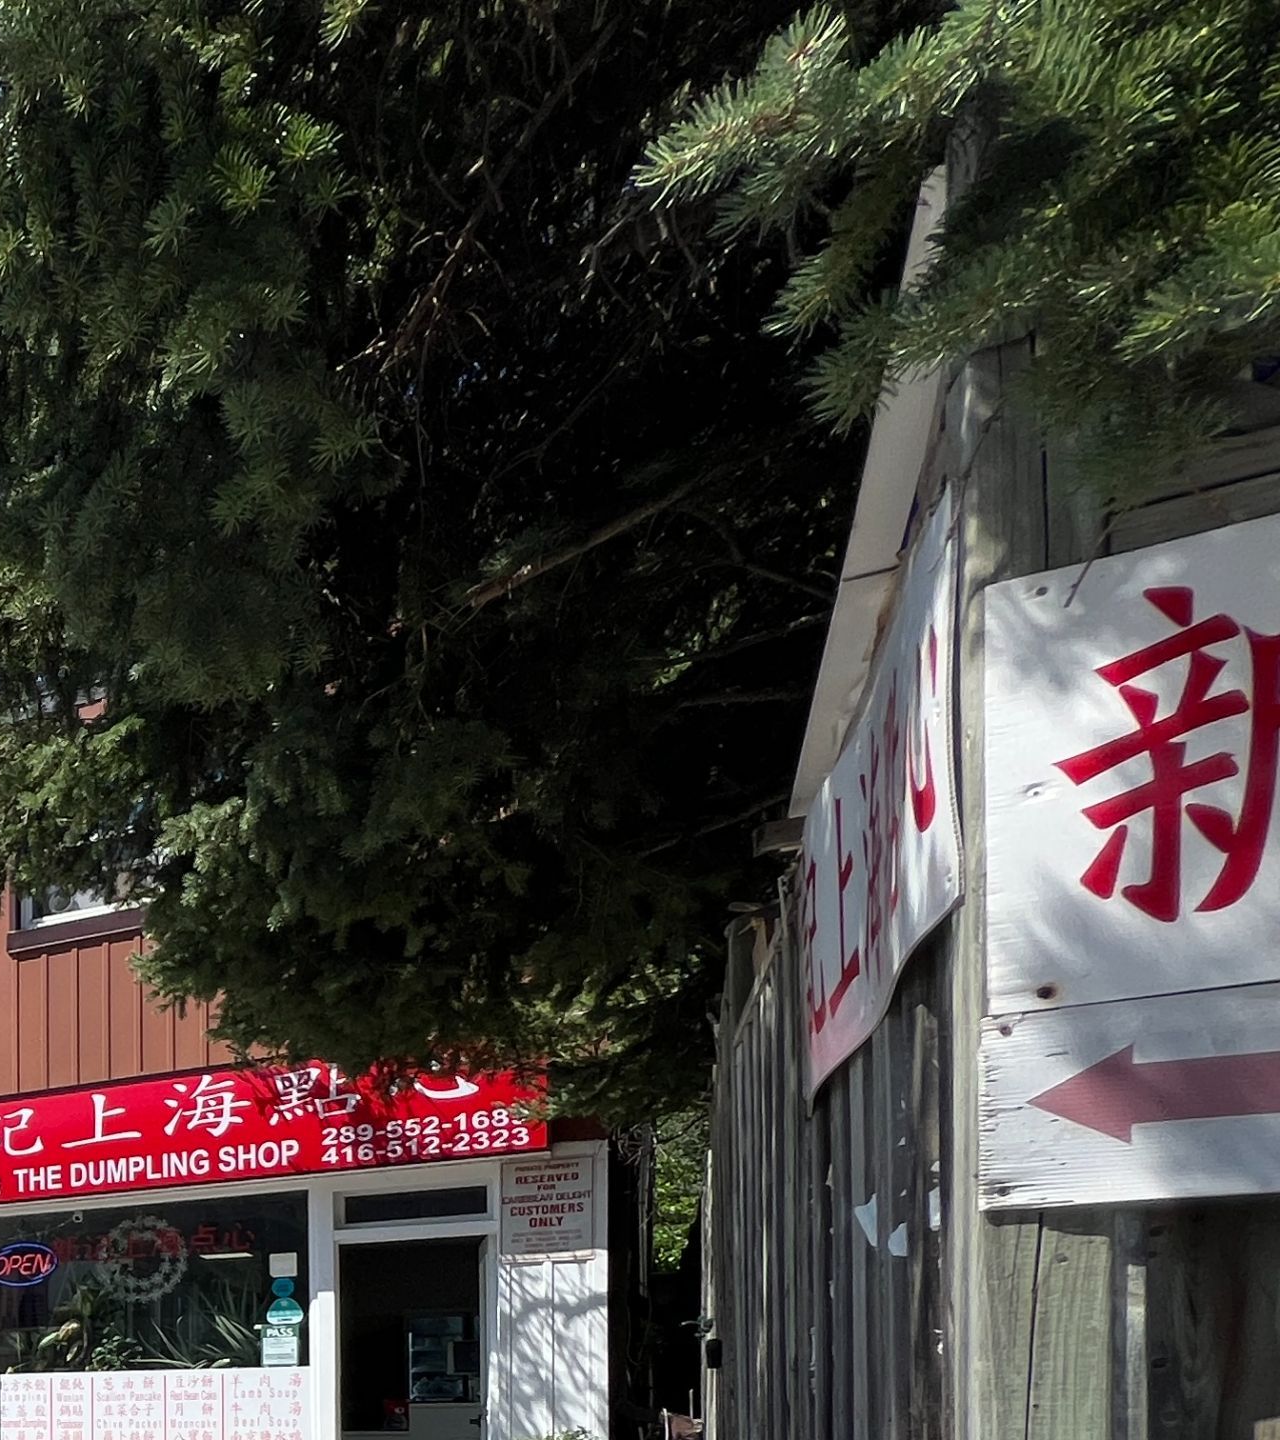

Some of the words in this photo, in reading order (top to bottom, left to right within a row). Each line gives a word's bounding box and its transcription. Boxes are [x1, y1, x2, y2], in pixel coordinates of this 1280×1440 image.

[321, 1107, 527, 1146] 289-552-168
[321, 1126, 530, 1166] 416-512-2323
[13, 1164, 63, 1193] THE
[70, 1150, 210, 1188] DUMPLING
[218, 1139, 300, 1173] SHOP
[544, 1161, 580, 1171] PROPERTY
[515, 1171, 580, 1185] RESERVED
[536, 1183, 556, 1192] FOR
[510, 1201, 584, 1217] CUSTOMERS
[529, 1216, 564, 1228] ONLY
[266, 1327, 294, 1338] PASS
[269, 1387, 298, 1400] Soup
